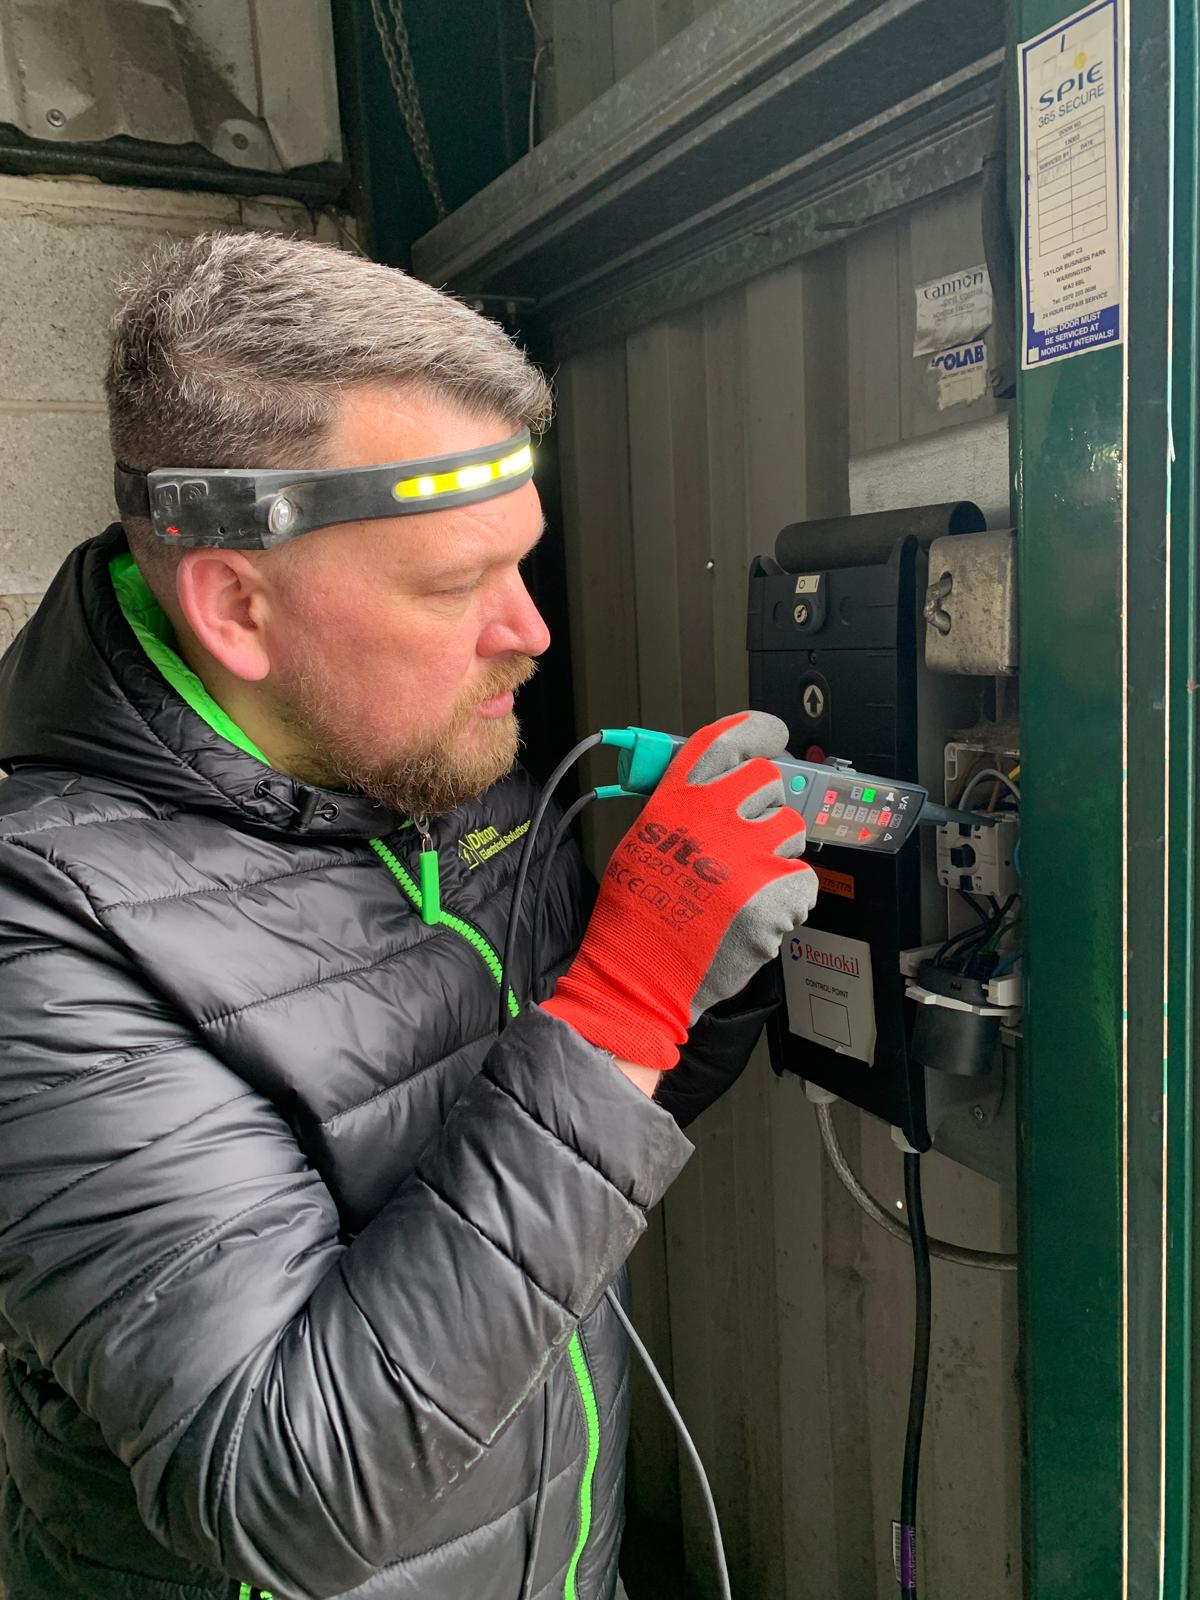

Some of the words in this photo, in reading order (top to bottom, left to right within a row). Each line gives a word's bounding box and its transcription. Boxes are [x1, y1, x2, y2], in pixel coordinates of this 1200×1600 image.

[1040, 61, 1103, 111] SPIE
[1038, 110, 1055, 128] 365
[1059, 83, 1104, 117] SECURE
[1043, 265, 1063, 277] TAYLOR
[1064, 255, 1090, 268] BUSINESS
[1091, 249, 1106, 259] PARK
[1062, 249, 1075, 259] UNIT
[923, 271, 983, 300] cannon
[1056, 265, 1092, 282] WARRINGTON
[1049, 305, 1064, 316] HOUR
[1064, 298, 1084, 310] REPAIR
[1085, 291, 1108, 304] SERVICE
[1044, 325, 1059, 336] THIS
[1059, 318, 1079, 330] DOOR
[1080, 311, 1101, 325] MUST
[1045, 336, 1054, 346] BE
[1055, 326, 1089, 343] SERVICED
[1089, 323, 1100, 332] AT
[1040, 340, 1073, 356] MONTHLY
[1073, 329, 1114, 347] INTERVALS!
[822, 803, 830, 812] 12
[467, 826, 499, 849] Dixon
[479, 837, 508, 860] Electrical
[624, 841, 674, 876] KF320
[638, 822, 729, 885] site
[805, 943, 860, 975] Rentokil
[805, 977, 830, 992] CONTROL
[832, 987, 849, 998] POINT
